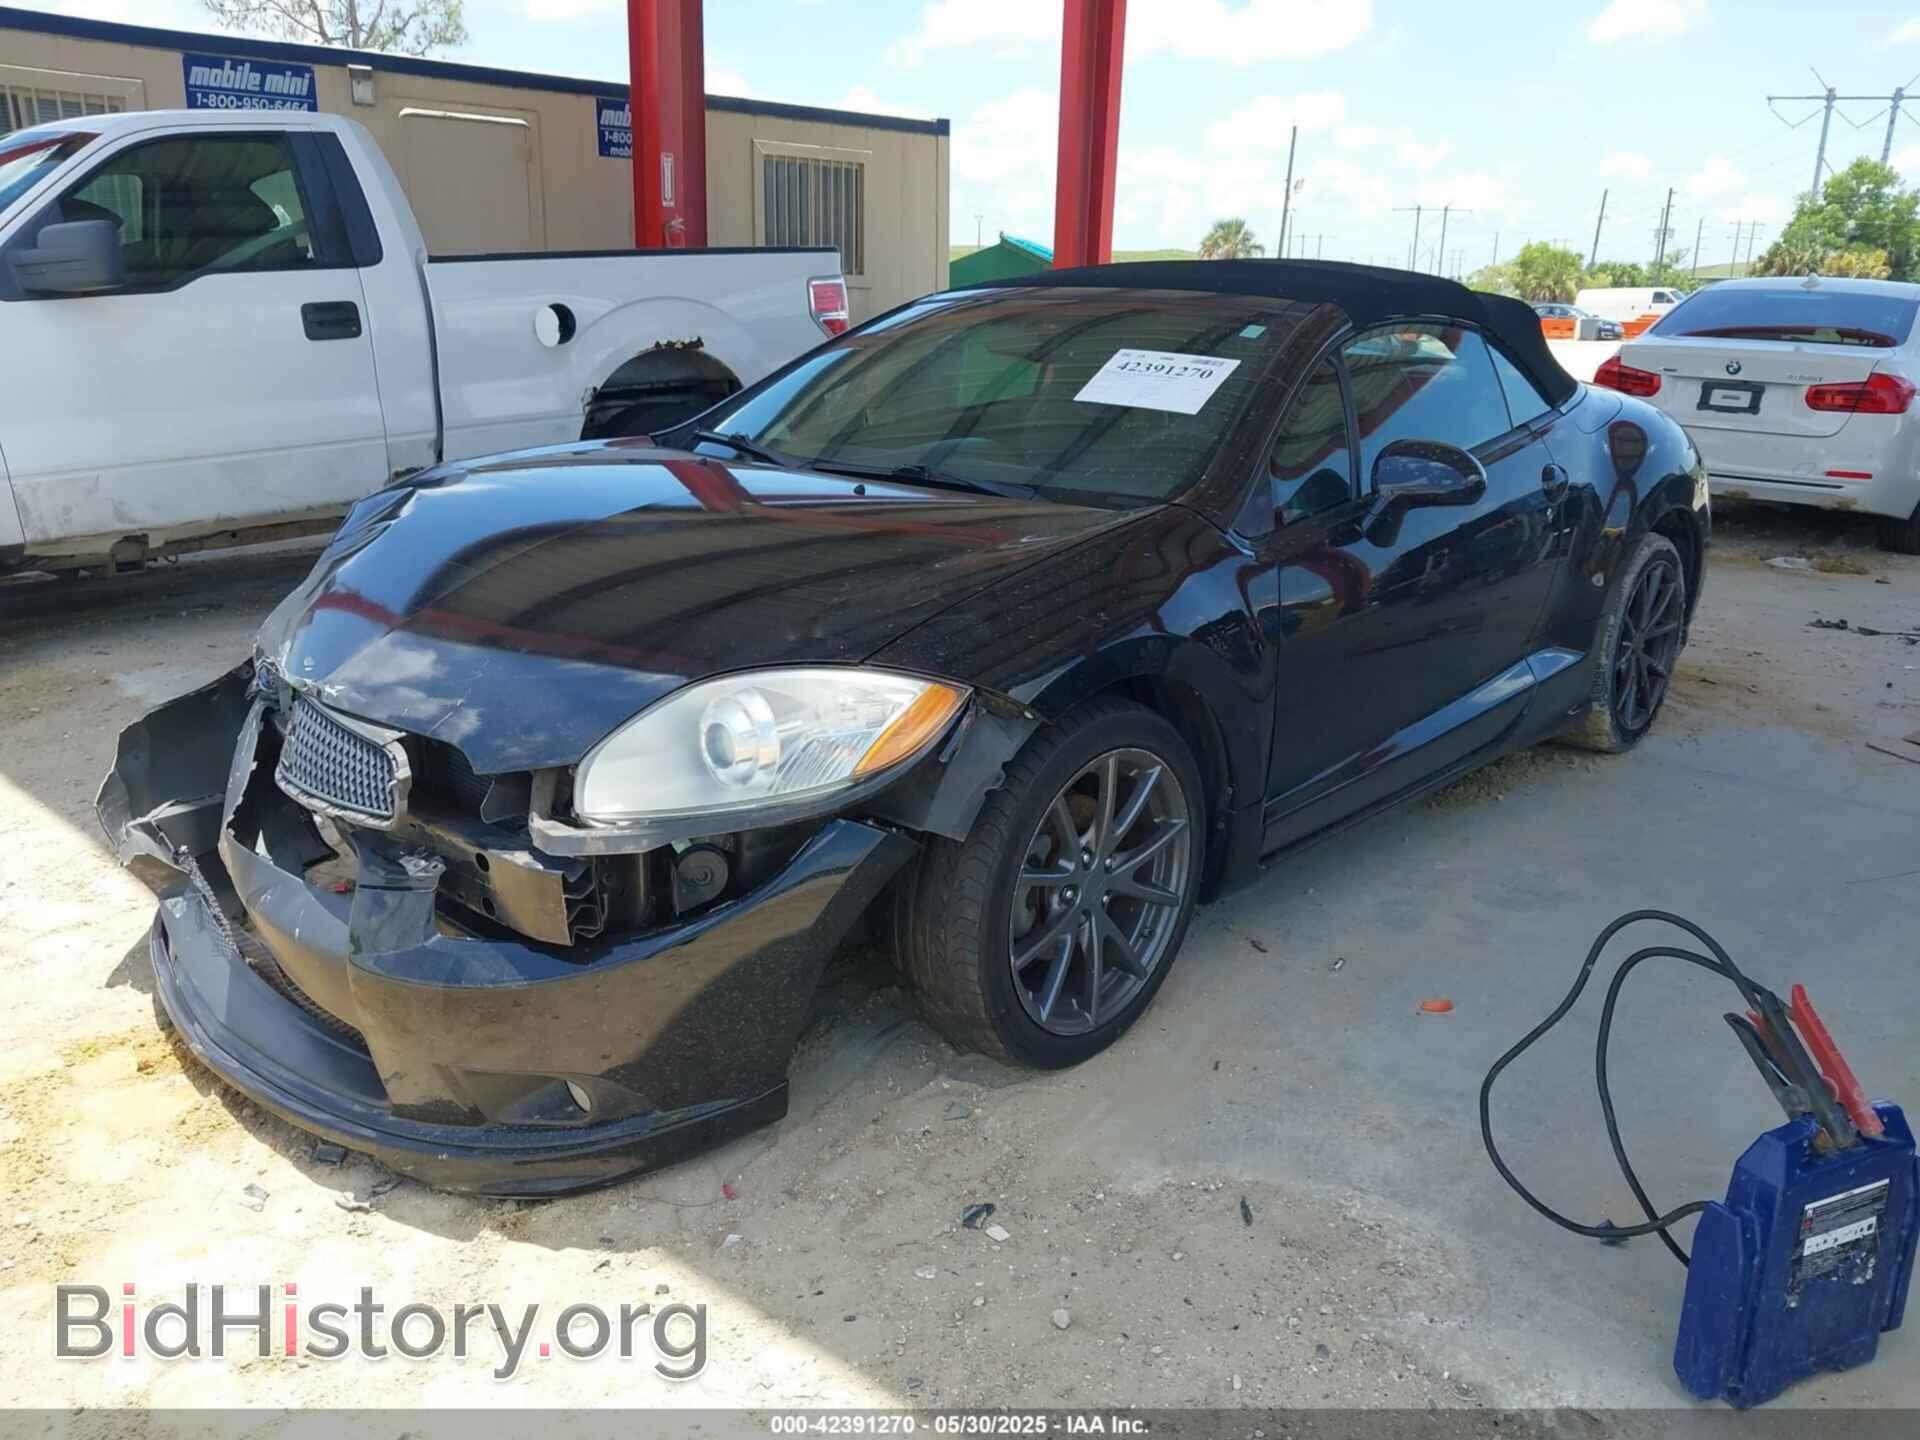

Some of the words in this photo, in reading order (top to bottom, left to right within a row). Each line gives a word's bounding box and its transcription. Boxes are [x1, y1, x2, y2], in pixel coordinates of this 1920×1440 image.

[189, 60, 261, 91] mobile
[264, 70, 311, 96] mini
[1116, 360, 1214, 380] 42391270
